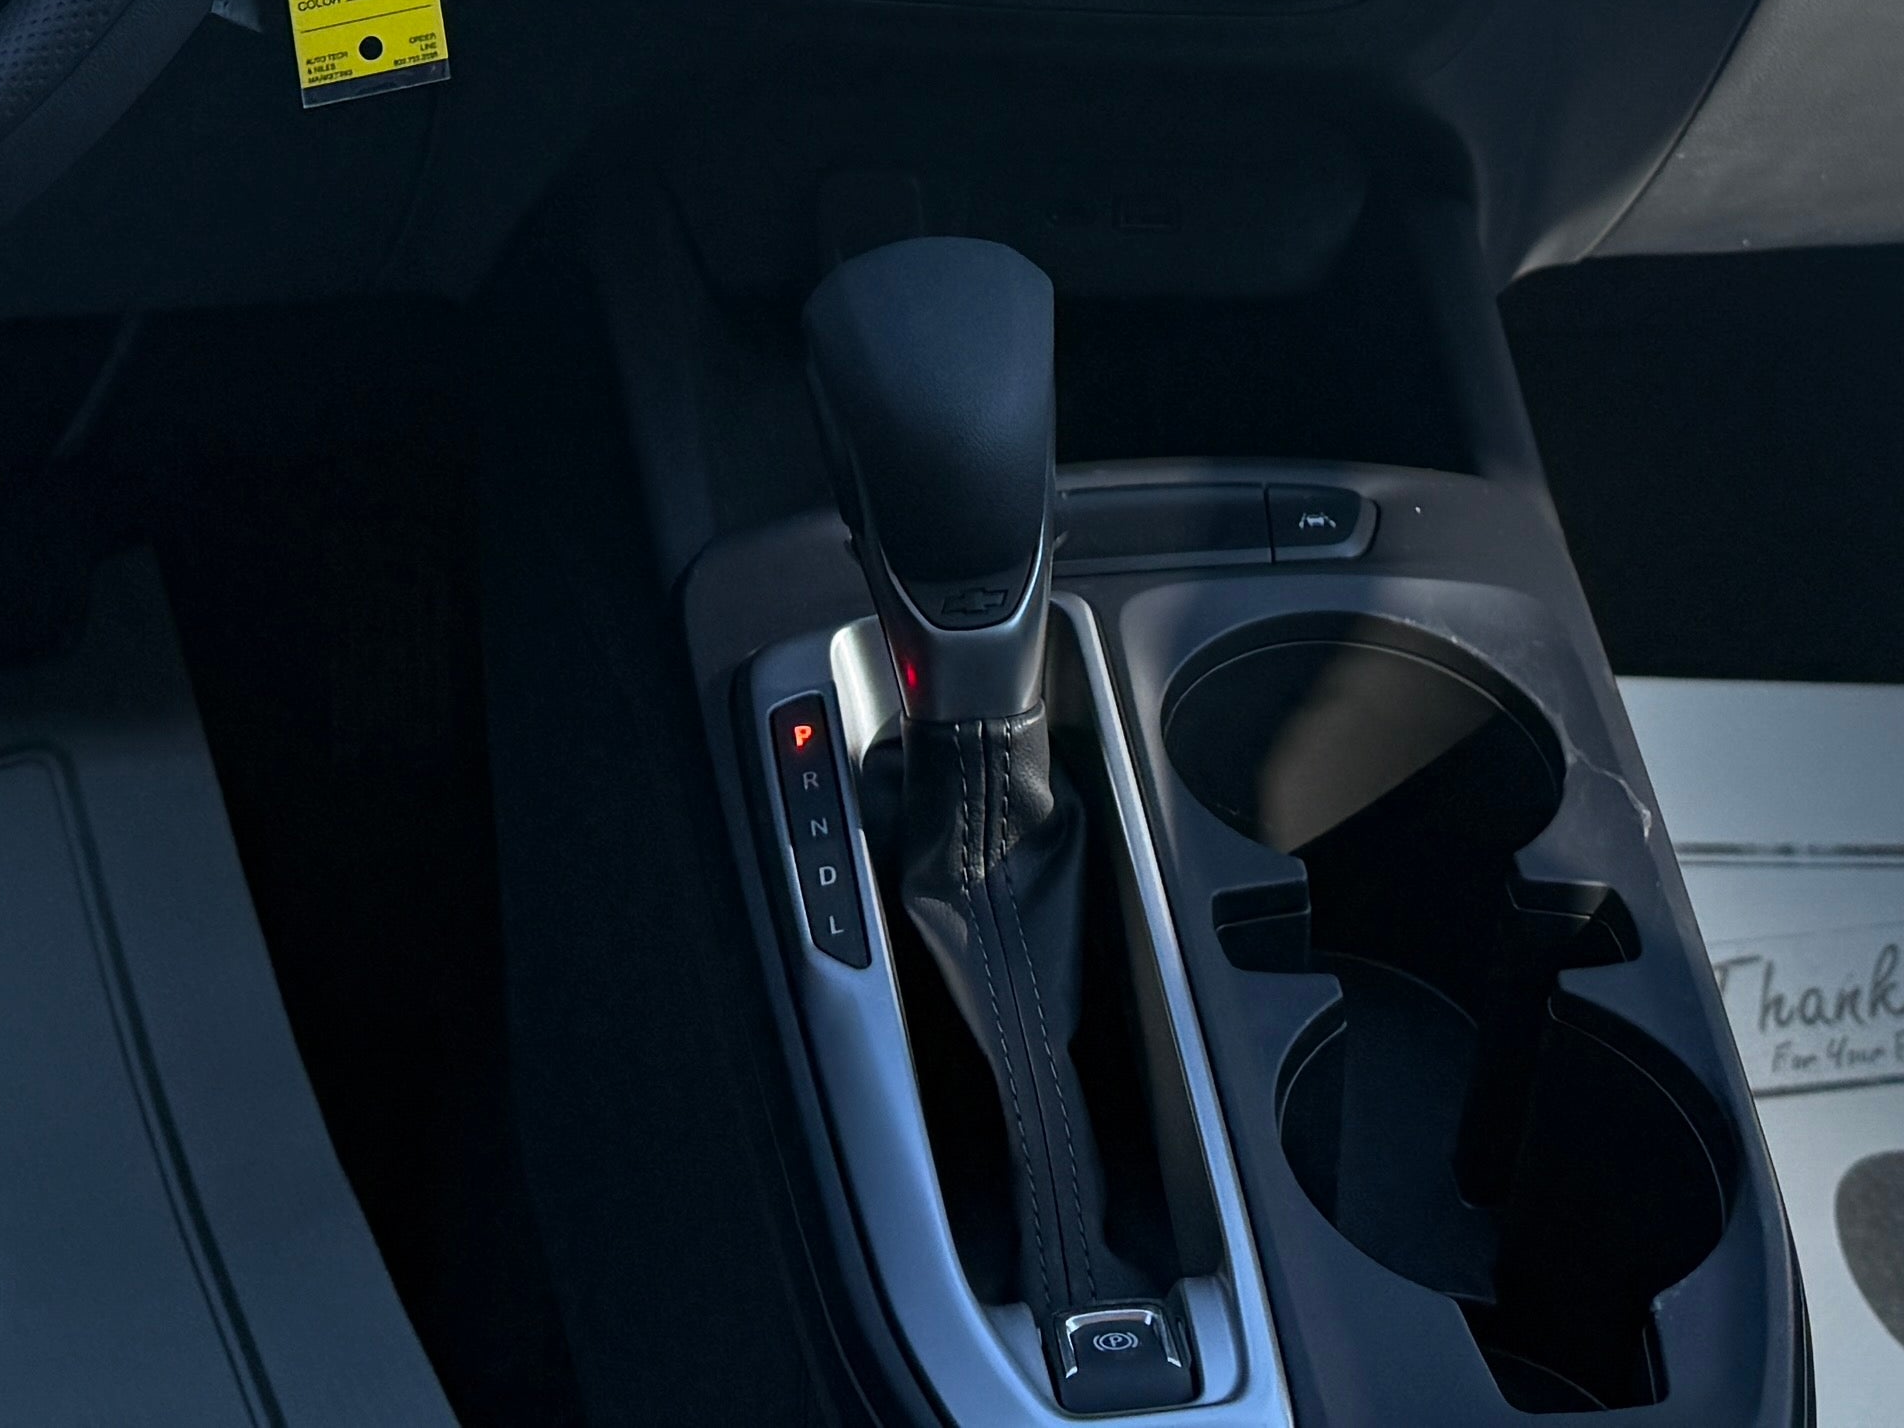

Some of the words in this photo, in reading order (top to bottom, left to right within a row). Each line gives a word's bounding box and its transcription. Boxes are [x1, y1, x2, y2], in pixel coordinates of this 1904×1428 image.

[791, 725, 813, 747] P
[802, 770, 819, 790] R
[810, 816, 829, 836] N
[819, 864, 838, 886] D
[829, 914, 845, 936] L
